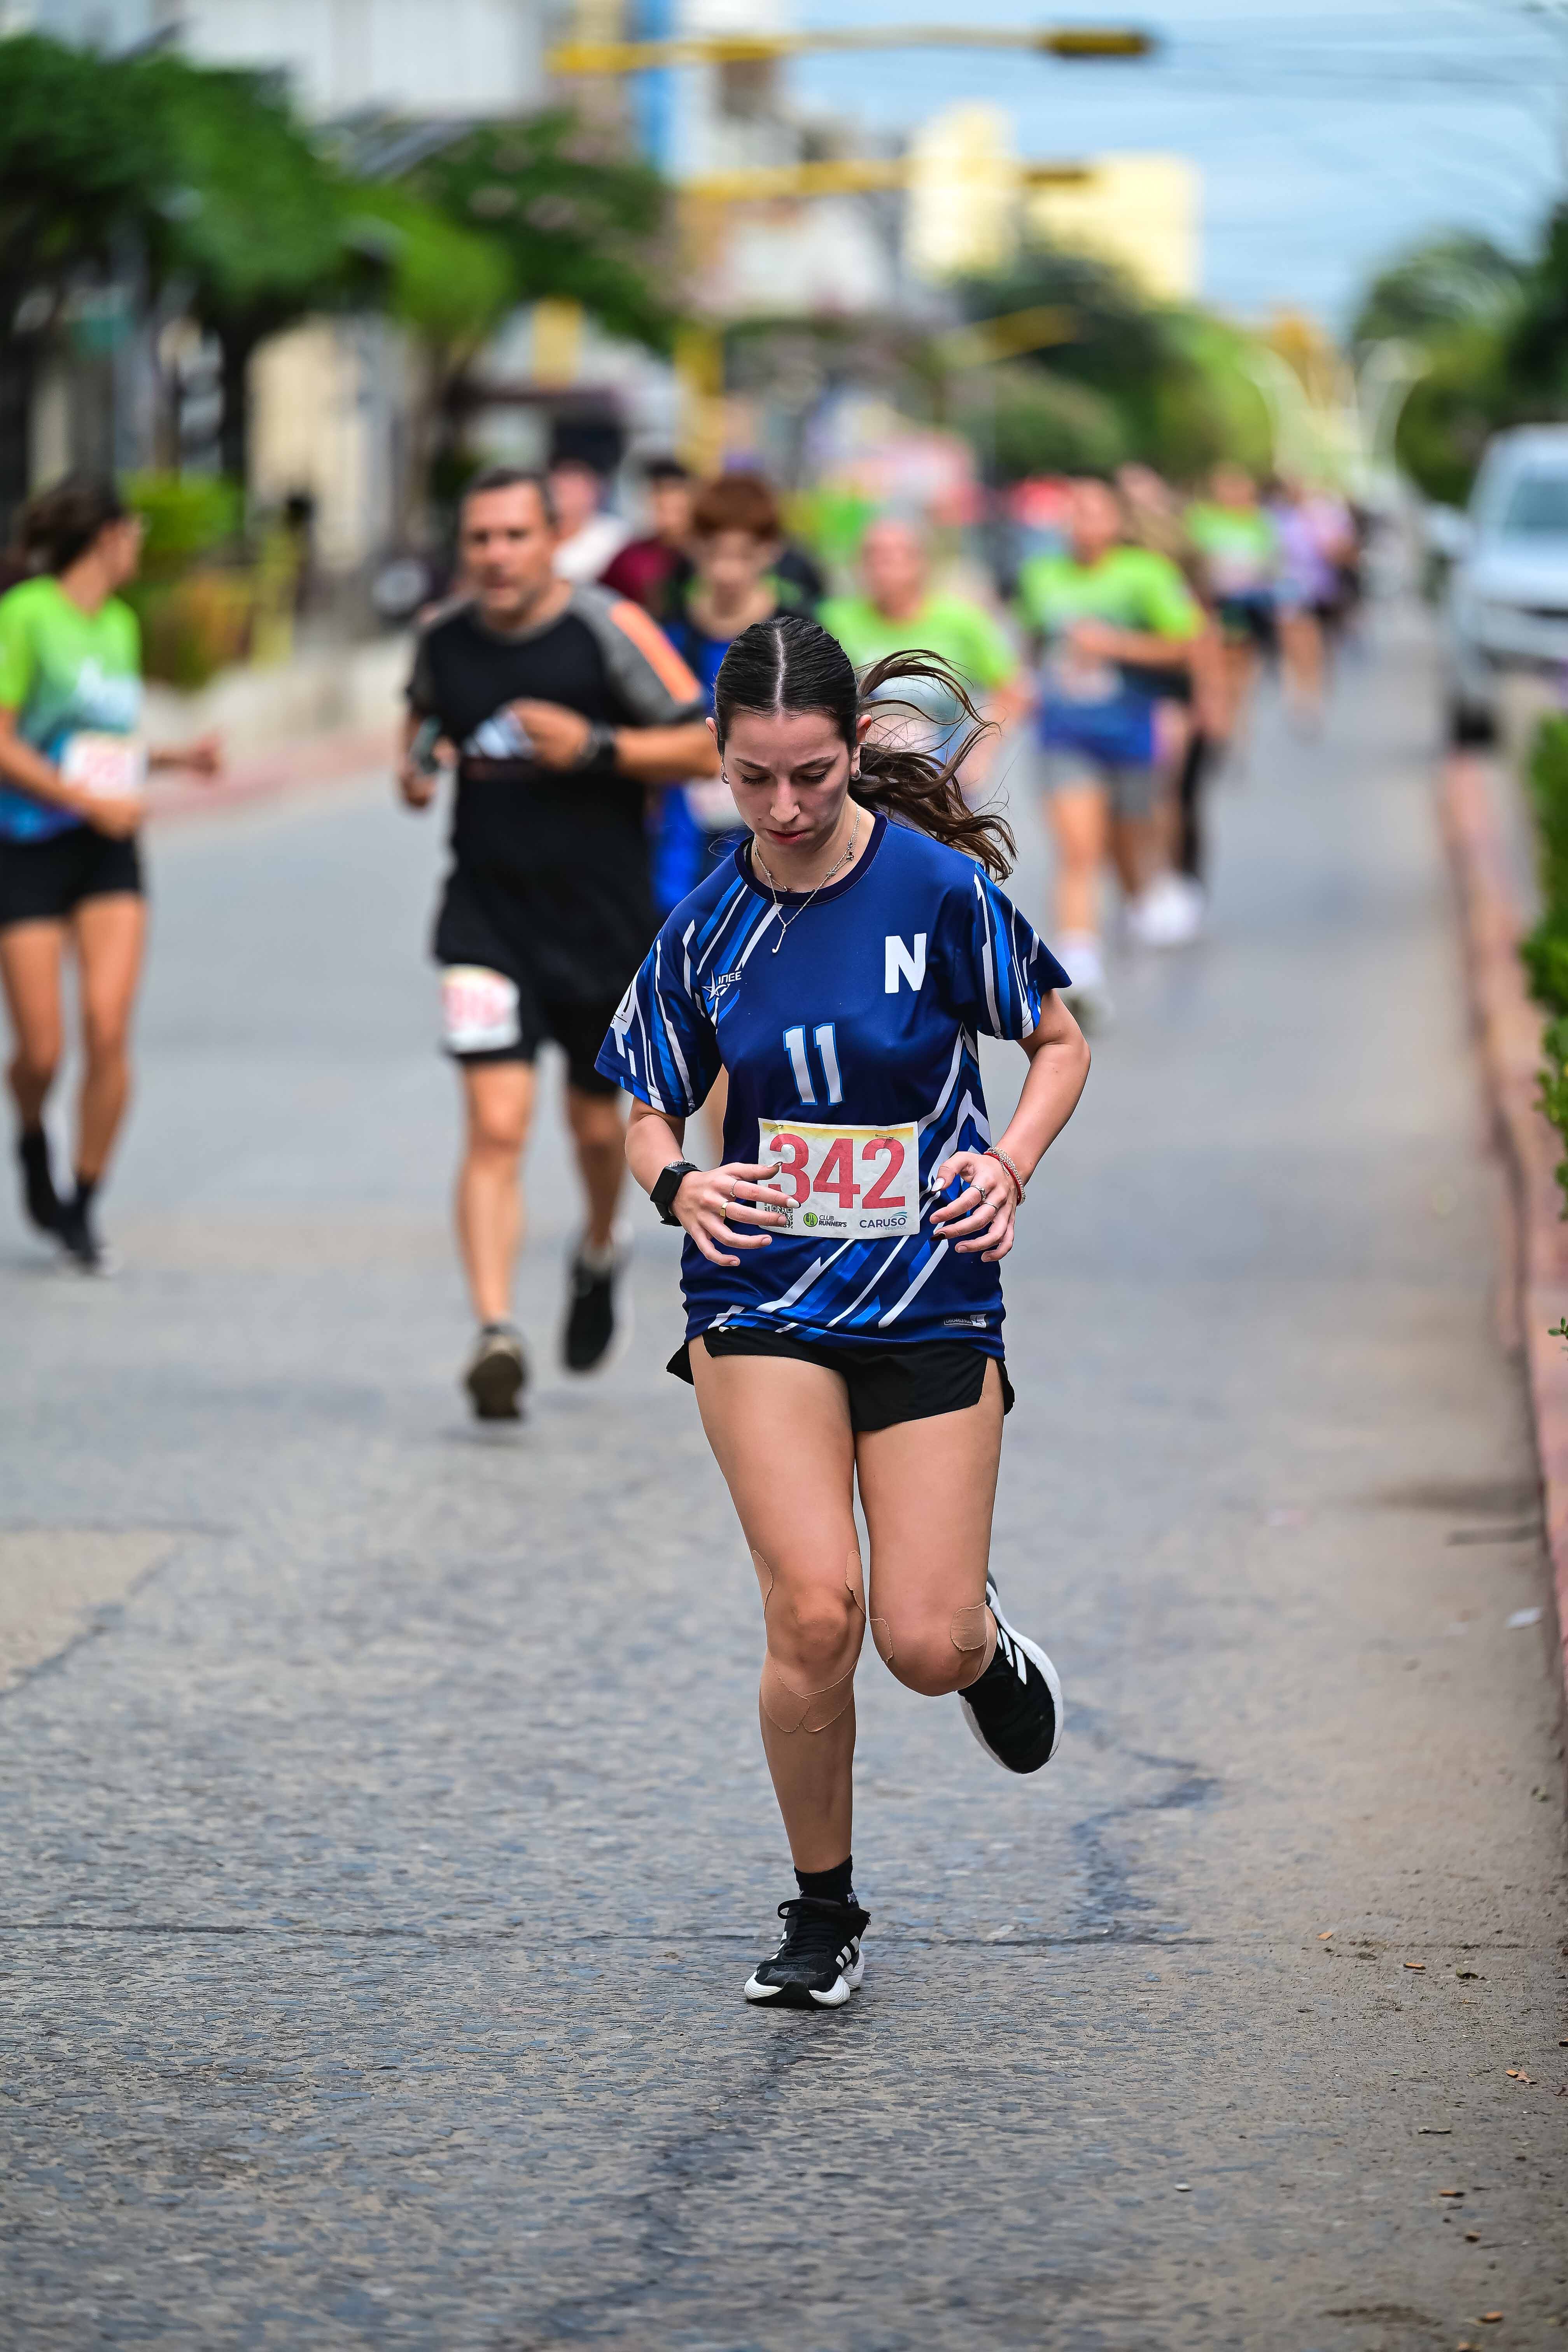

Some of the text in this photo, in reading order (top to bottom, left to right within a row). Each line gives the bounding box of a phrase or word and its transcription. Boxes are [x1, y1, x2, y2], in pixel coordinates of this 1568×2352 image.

[885, 933, 926, 994] N
[783, 1023, 843, 1105] 11
[768, 1133, 905, 1209] 342
[859, 1217, 906, 1228] CARUSO
